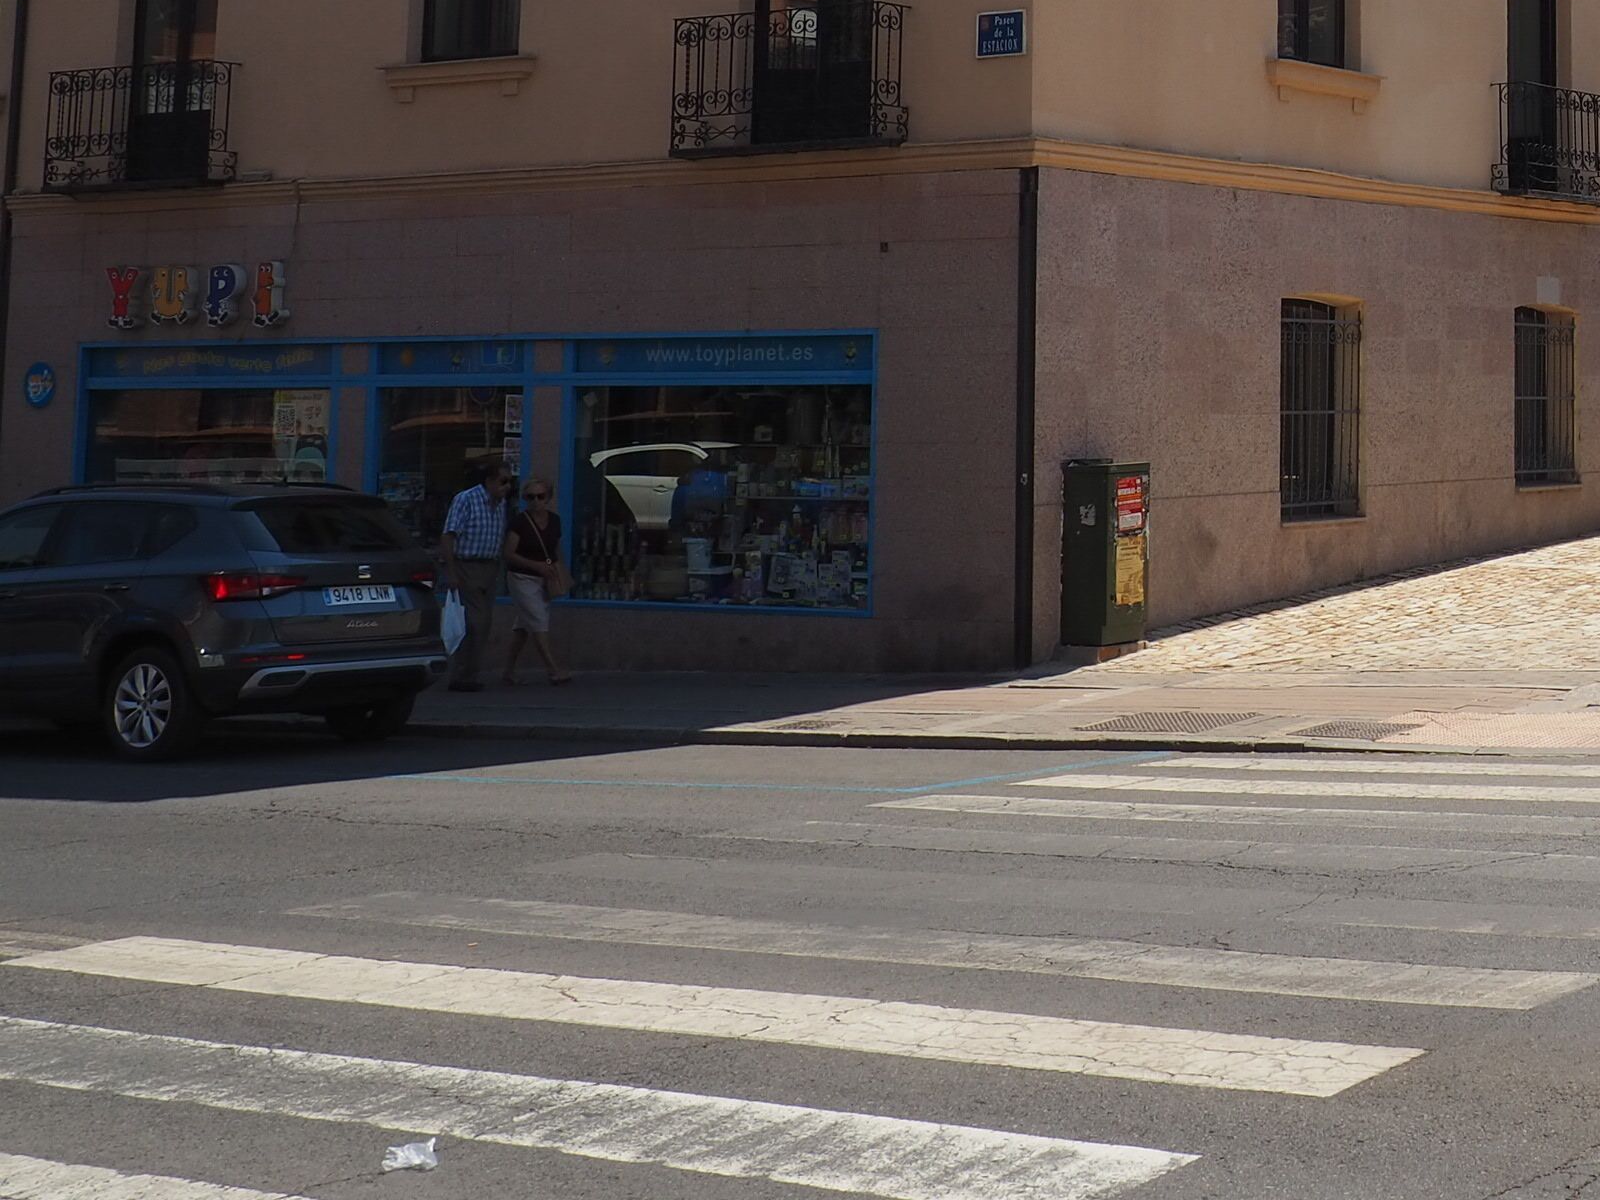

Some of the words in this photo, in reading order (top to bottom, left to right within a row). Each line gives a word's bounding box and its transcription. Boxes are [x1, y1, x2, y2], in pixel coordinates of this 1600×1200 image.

[994, 16, 1015, 26] Paseo
[993, 28, 1003, 38] de
[1007, 26, 1014, 37] la
[105, 262, 289, 328] YUPI
[645, 343, 814, 367] www.toyplanet.es
[332, 587, 364, 602] 9418
